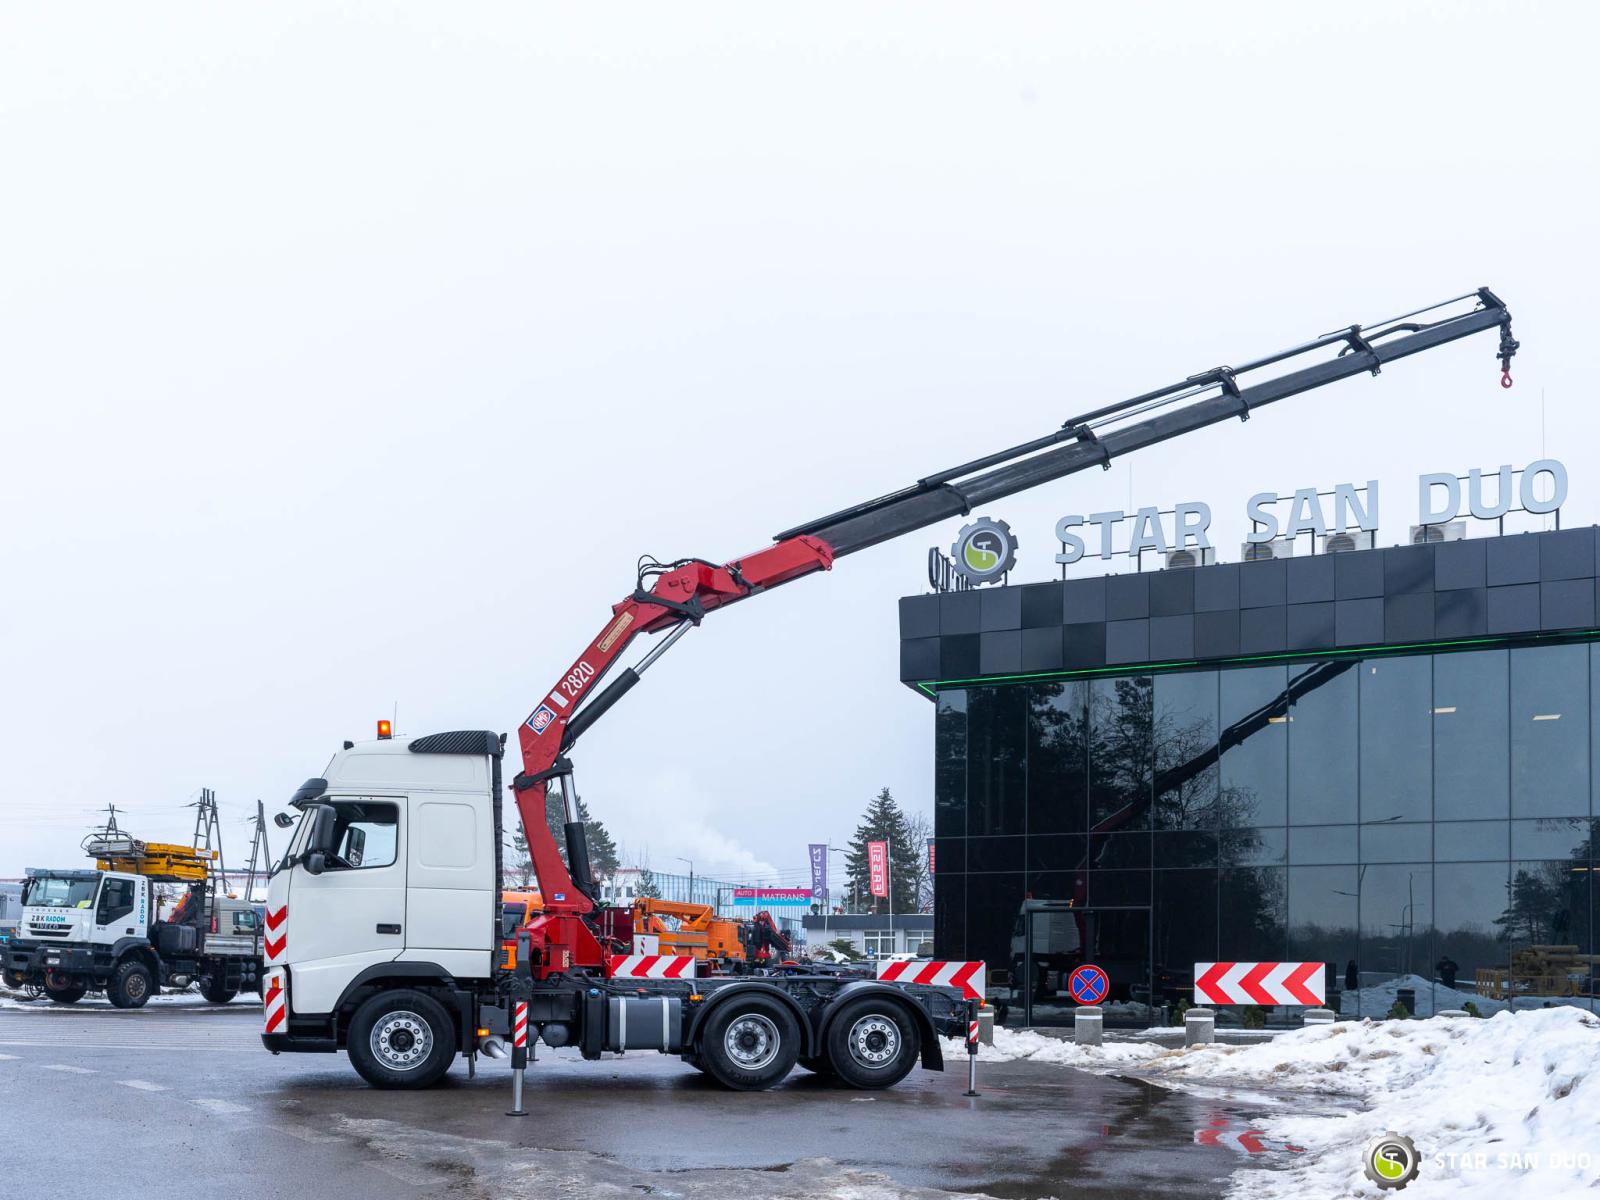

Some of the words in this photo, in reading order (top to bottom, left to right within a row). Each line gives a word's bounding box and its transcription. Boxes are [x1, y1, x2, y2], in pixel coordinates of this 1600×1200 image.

[1055, 501, 1211, 565] STAR
[1246, 479, 1379, 544] SAN
[1419, 459, 1568, 527] DUO
[562, 661, 595, 696] 2820
[533, 711, 550, 728] HMF
[761, 893, 806, 902] MATRANS
